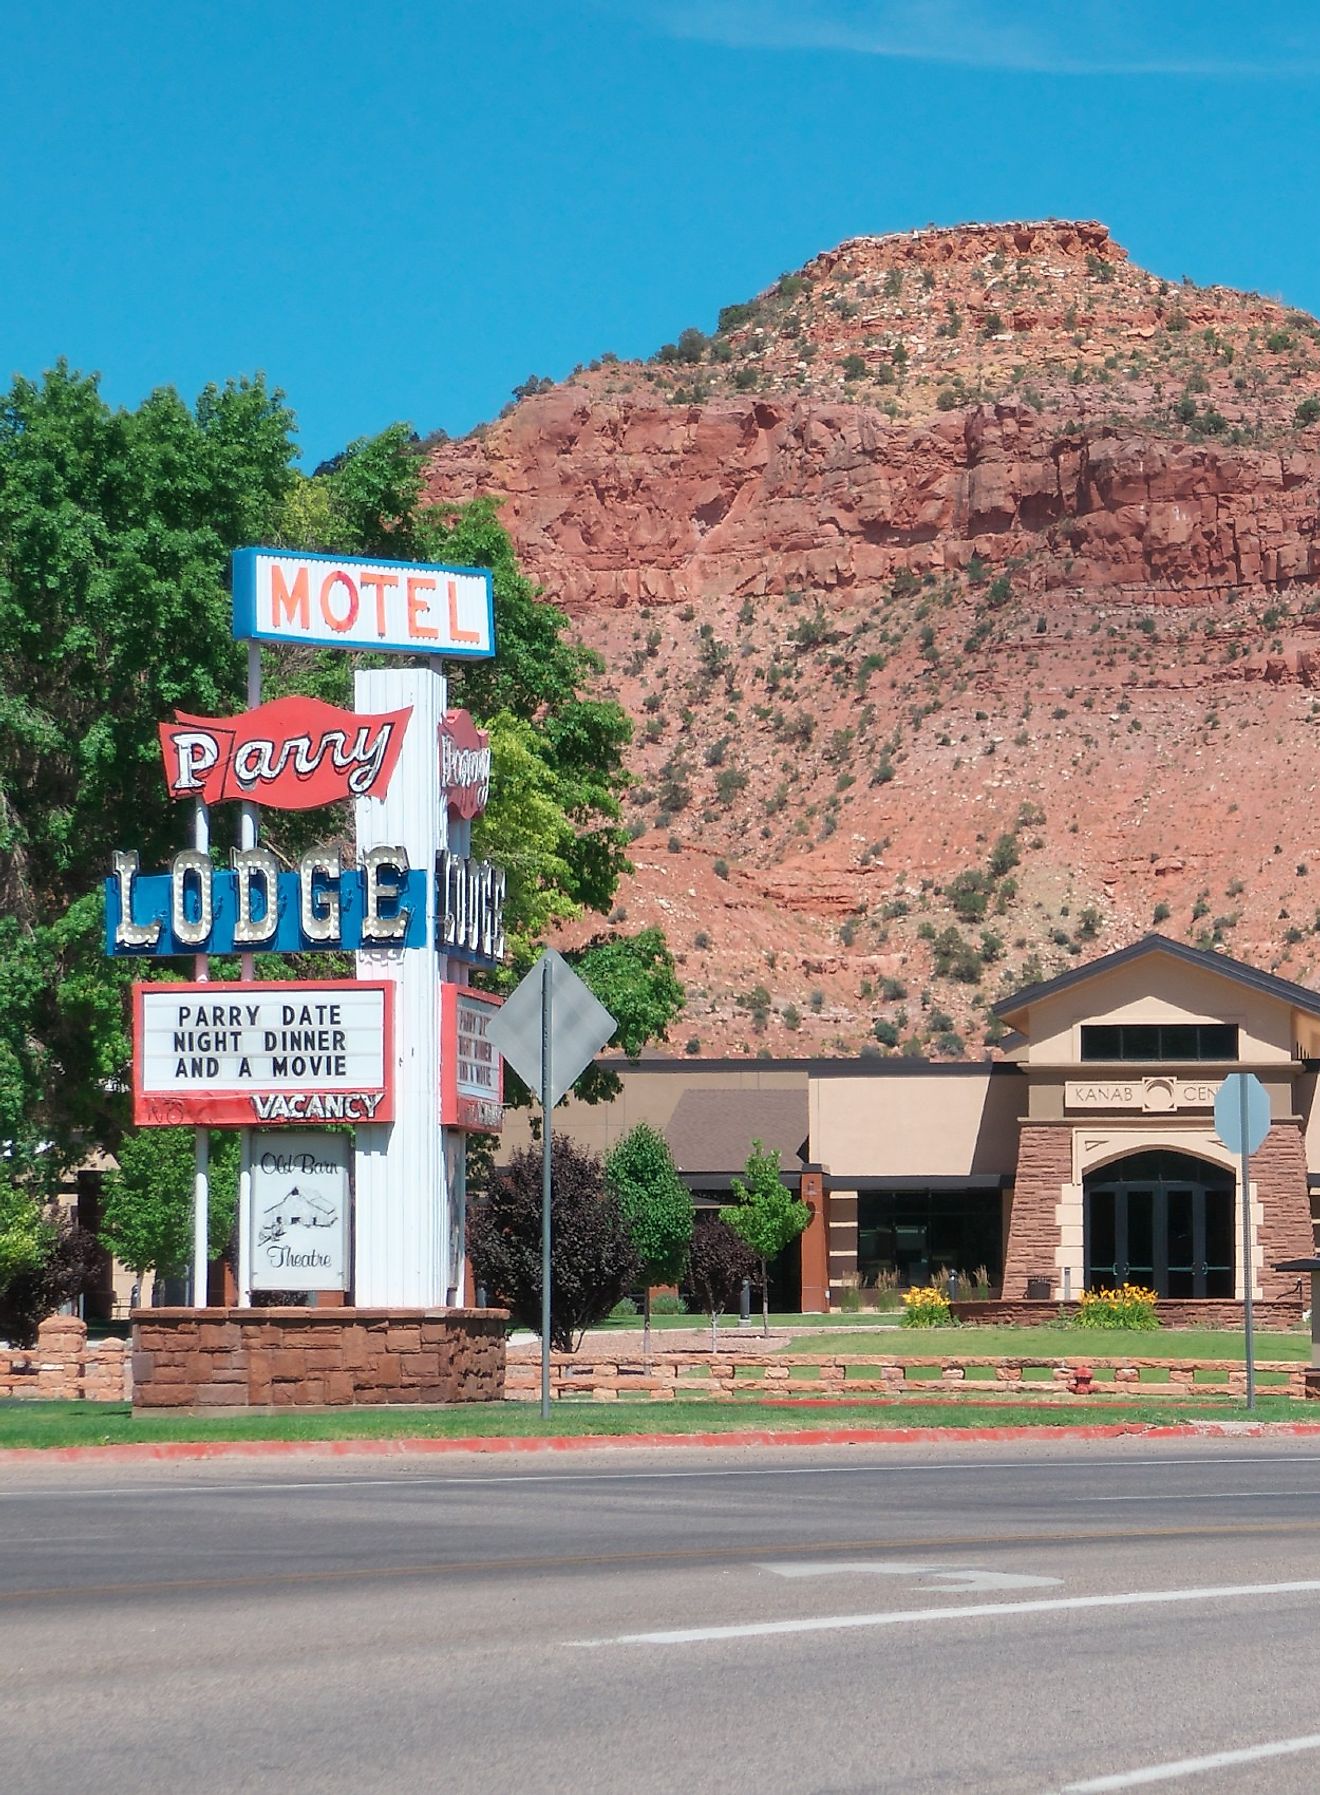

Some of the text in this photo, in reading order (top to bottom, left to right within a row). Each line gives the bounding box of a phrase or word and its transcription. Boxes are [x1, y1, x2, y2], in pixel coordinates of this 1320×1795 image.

[271, 565, 480, 643] MOTEL
[171, 721, 394, 796] Parry
[112, 845, 410, 946] LODGE
[178, 1004, 342, 1027] PARRY DATE
[173, 1030, 347, 1053] NIGHT DINNER
[175, 1055, 347, 1078] AND A MOVIE
[1075, 1086, 1217, 1102] KANAB CEN
[250, 1092, 385, 1120] VACANCY
[260, 1152, 339, 1175] Old Barn
[266, 1245, 332, 1269] Theatre
